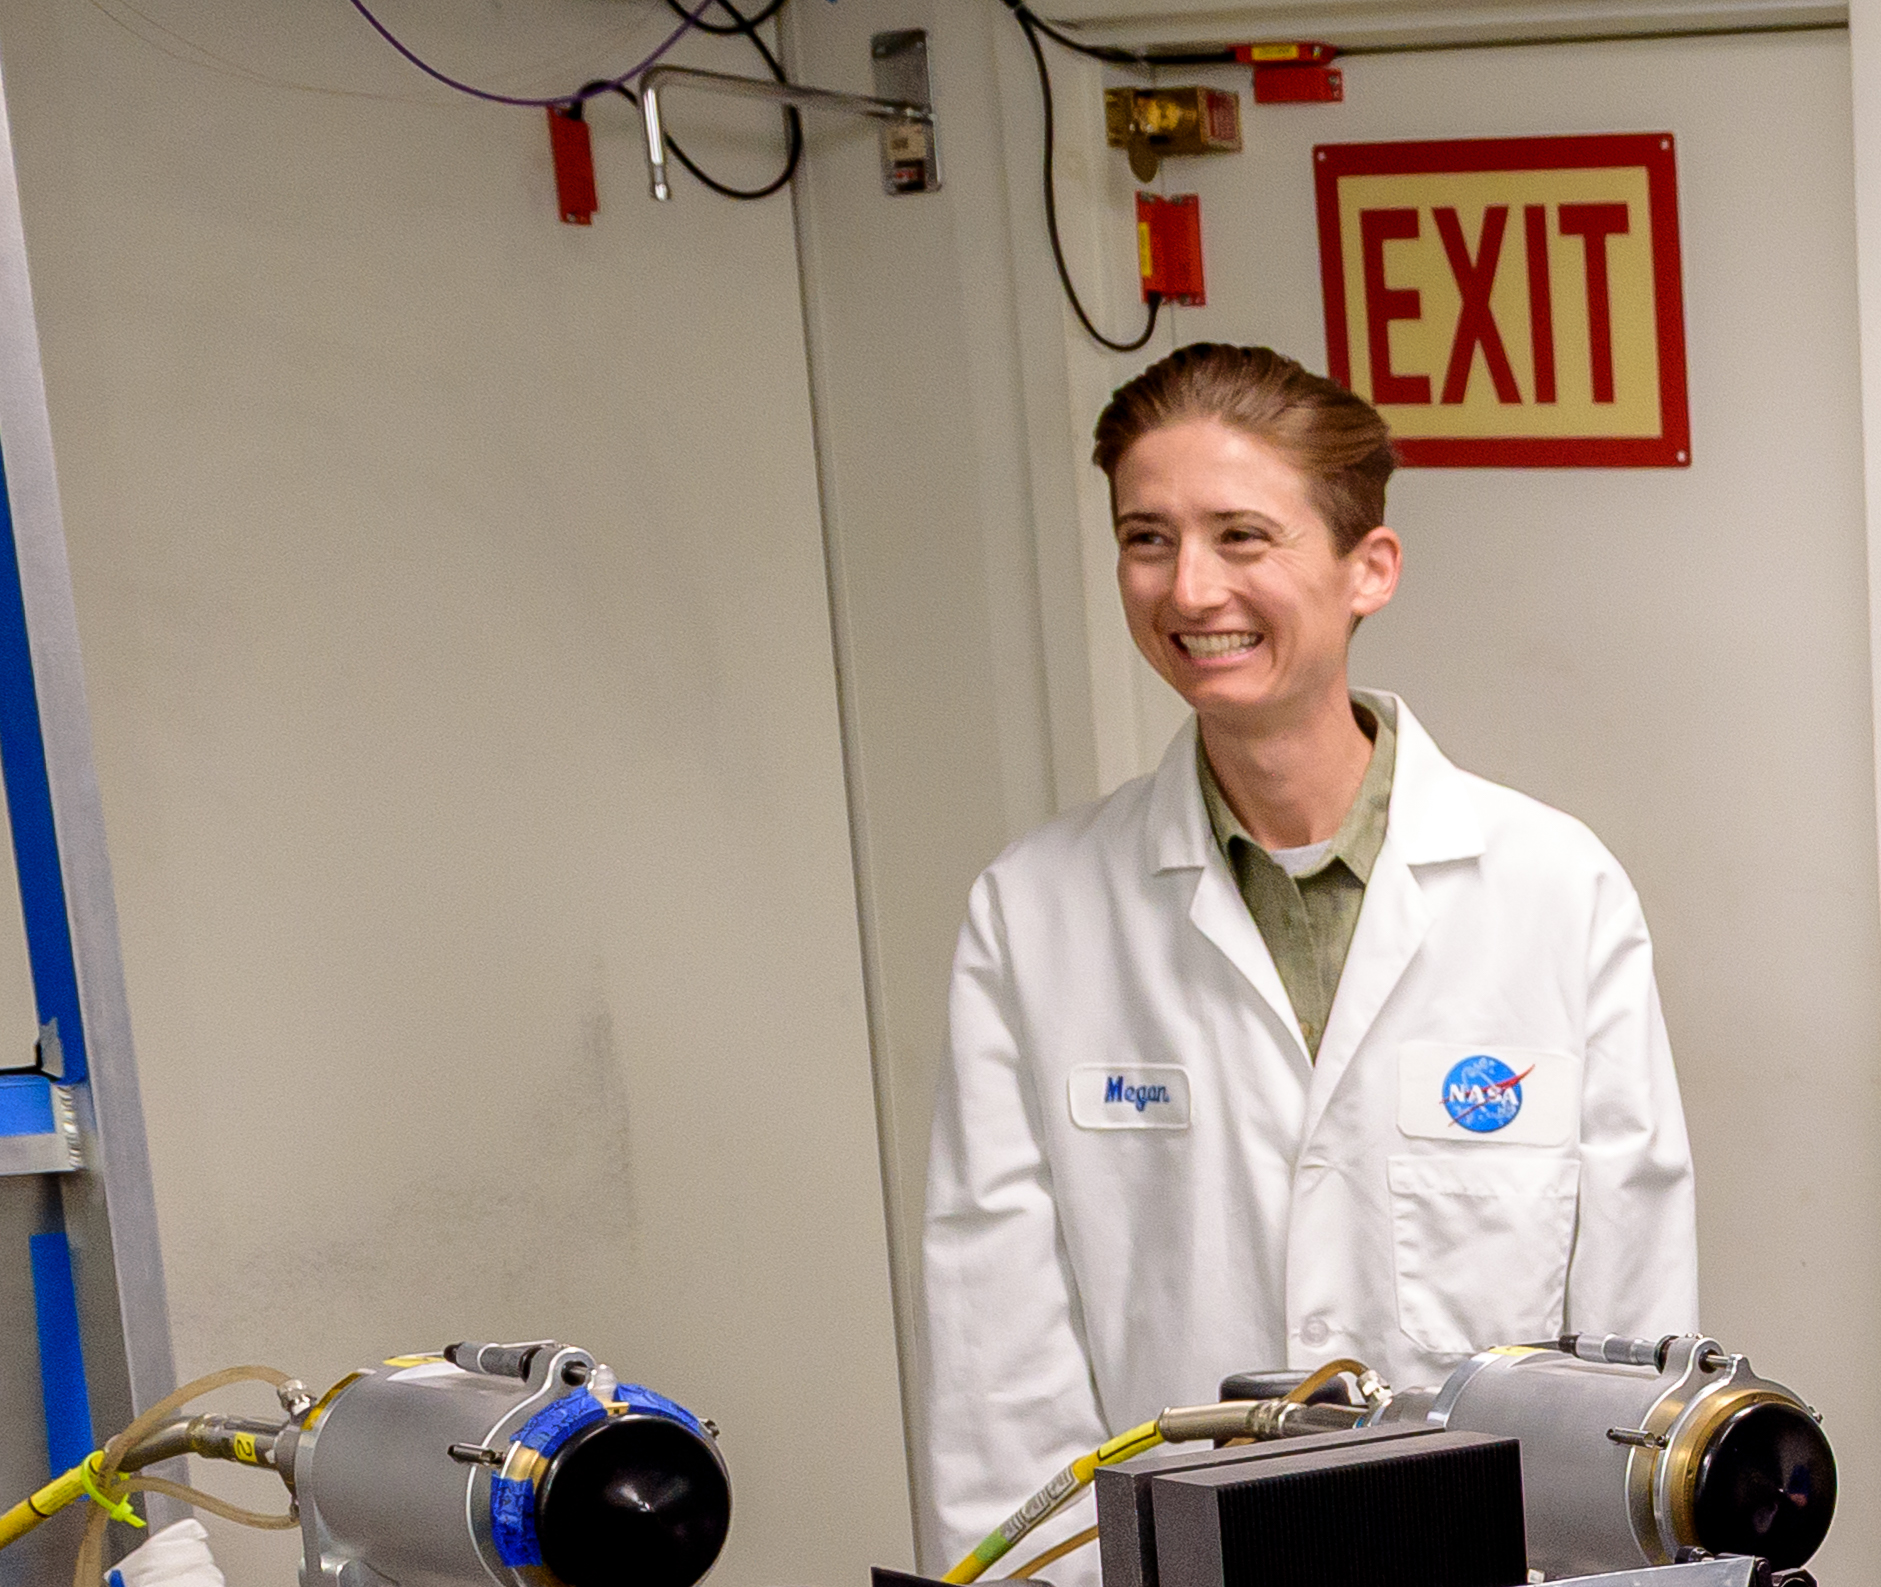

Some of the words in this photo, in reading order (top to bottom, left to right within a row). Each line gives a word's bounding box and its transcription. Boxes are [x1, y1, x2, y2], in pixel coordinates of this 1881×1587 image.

[1358, 203, 1629, 405] EXIT
[1104, 1075, 1170, 1112] Megan
[1449, 1083, 1519, 1106] NASA
